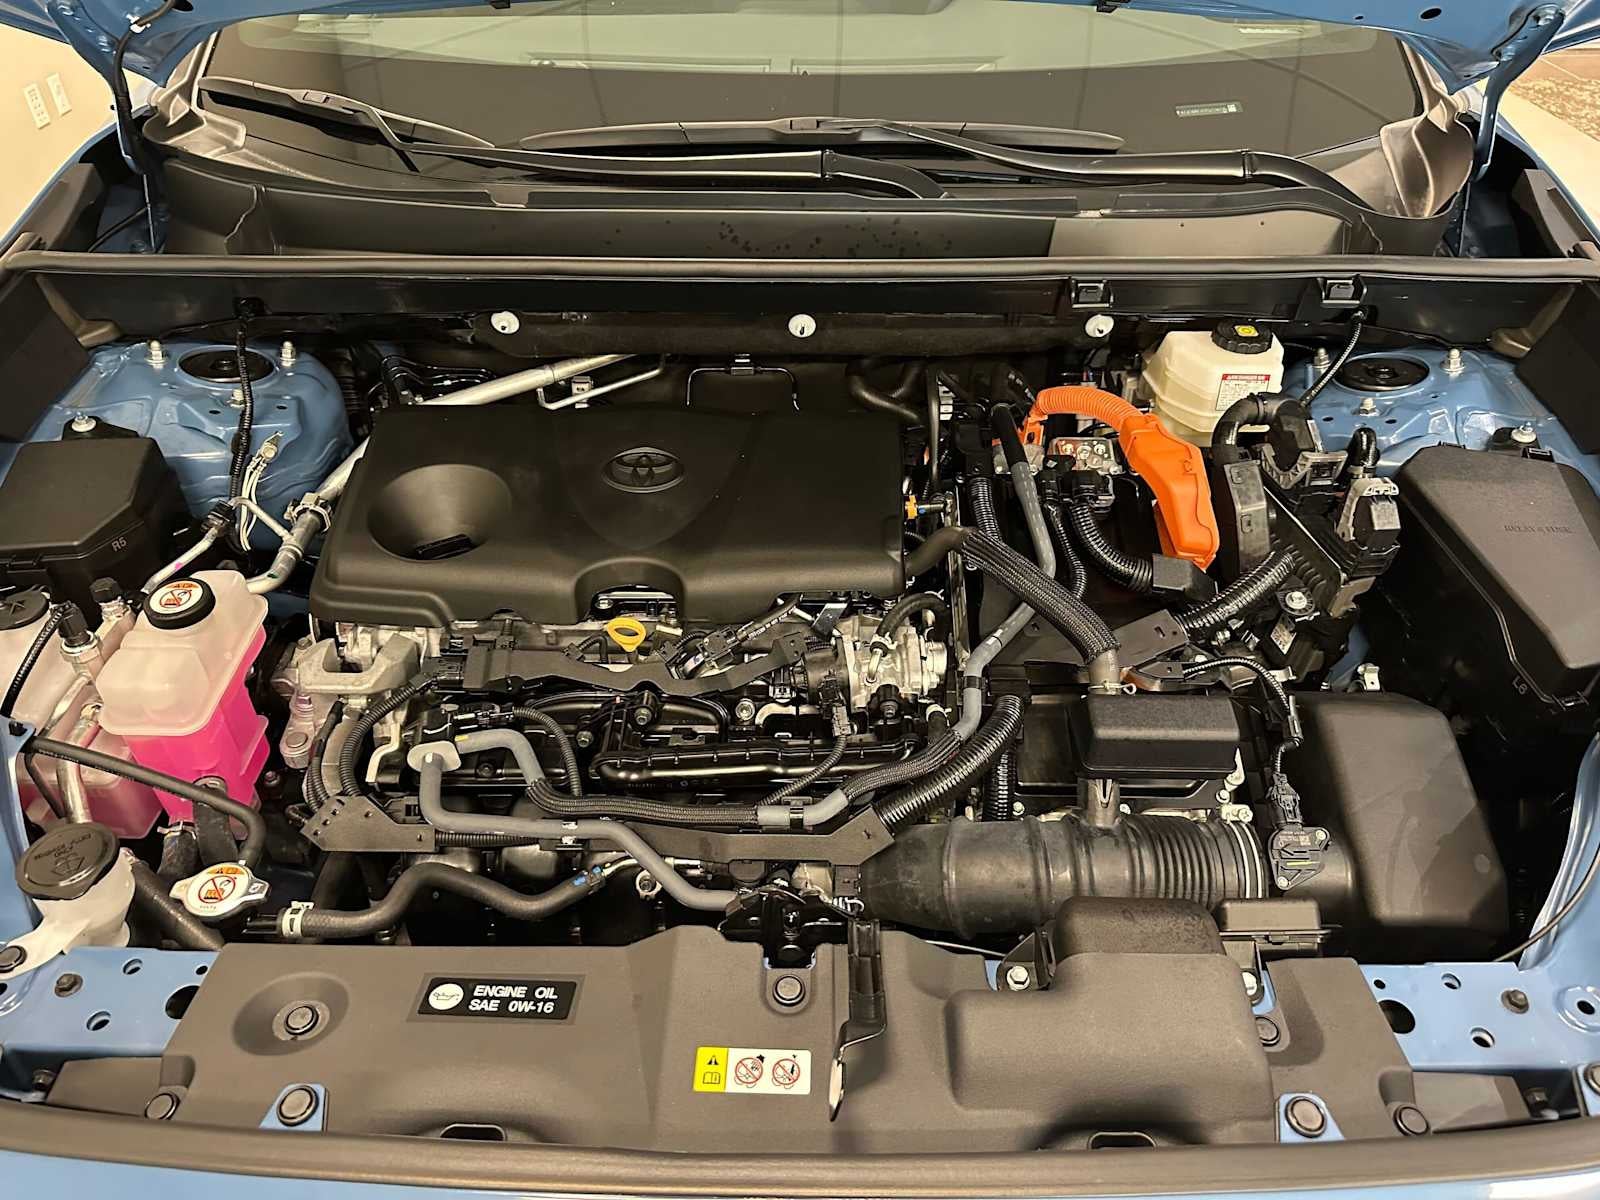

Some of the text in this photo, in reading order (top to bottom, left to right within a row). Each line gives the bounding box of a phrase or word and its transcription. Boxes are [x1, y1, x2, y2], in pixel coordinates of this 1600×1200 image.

[473, 984, 558, 1000] ENGINE OIL
[468, 999, 555, 1014] SAE 0W-16
